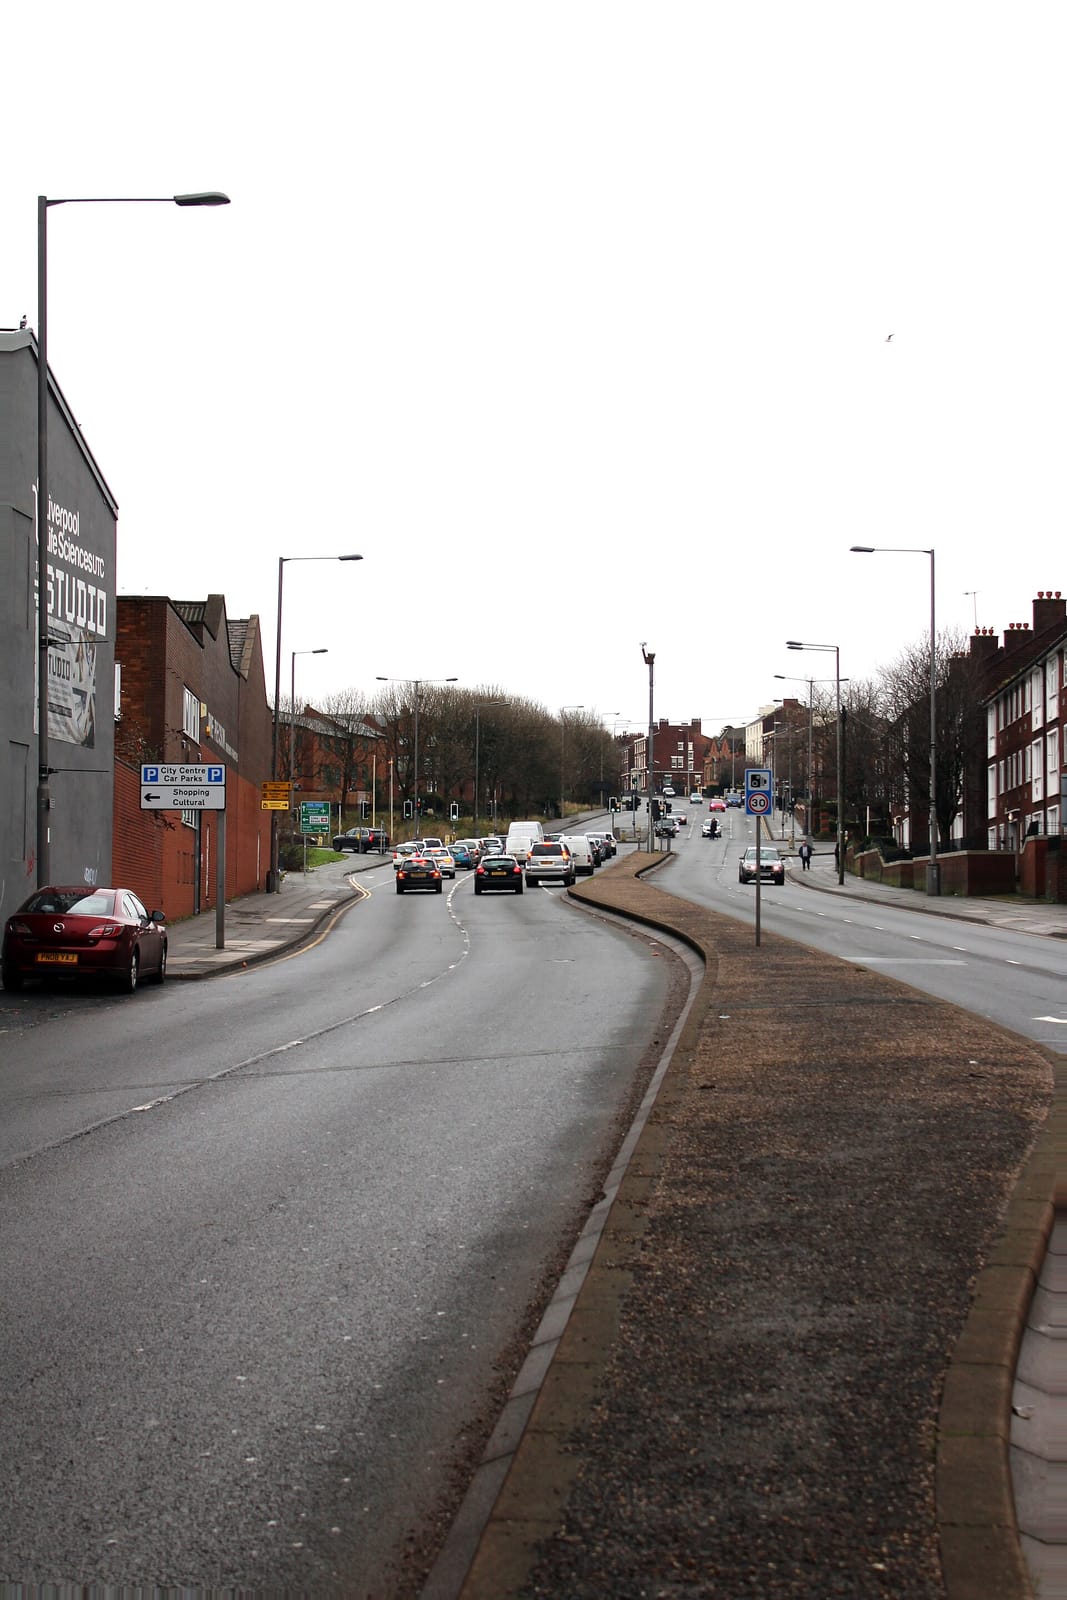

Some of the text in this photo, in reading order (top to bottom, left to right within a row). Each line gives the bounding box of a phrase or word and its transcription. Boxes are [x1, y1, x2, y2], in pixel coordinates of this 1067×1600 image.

[46, 494, 80, 537] iverpool
[146, 768, 157, 781] P
[160, 767, 177, 775] City
[210, 768, 221, 781] P
[172, 788, 210, 797] Shopping
[172, 798, 206, 806] Cultural
[751, 798, 766, 808] 30
